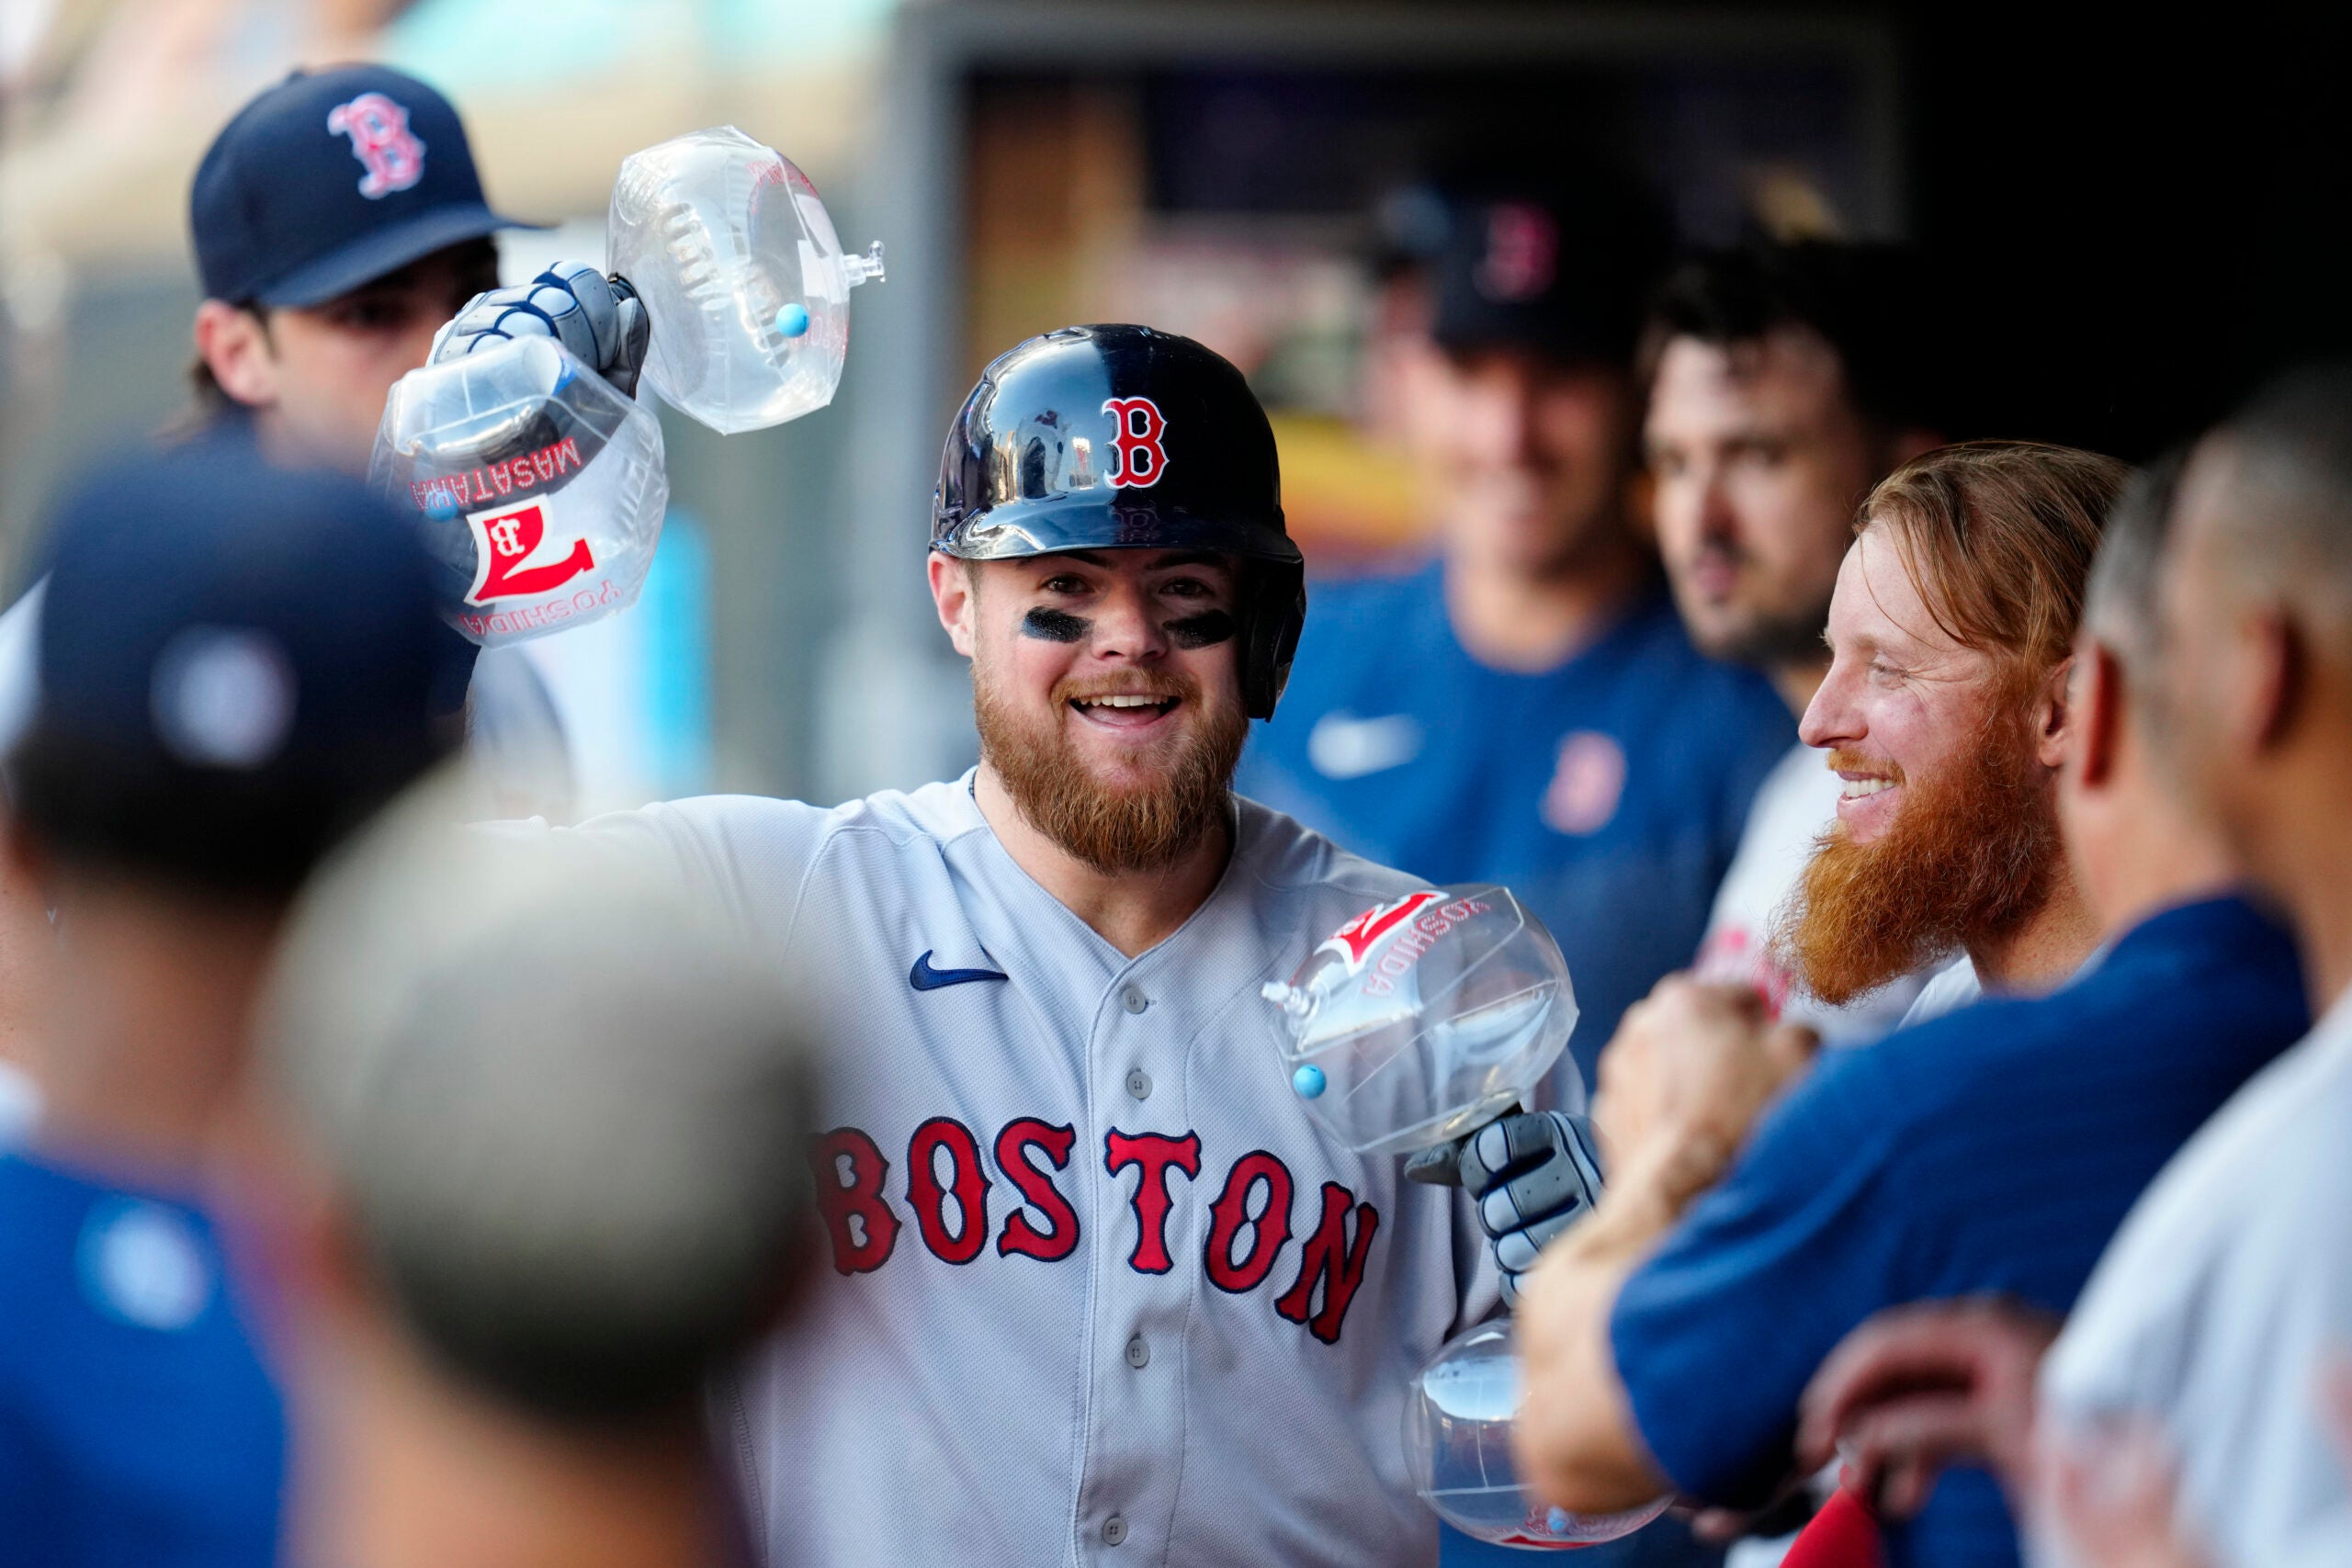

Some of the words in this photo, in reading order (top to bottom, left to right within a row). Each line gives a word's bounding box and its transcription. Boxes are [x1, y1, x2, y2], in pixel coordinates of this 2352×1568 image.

[327, 93, 426, 200] B
[410, 436, 582, 513] MASATAKA
[1101, 395, 1170, 490] B
[469, 501, 597, 605] 7
[489, 517, 526, 558] B
[459, 579, 625, 637] YOSHIDA
[1363, 896, 1494, 998] YOSHIDA
[808, 1114, 1381, 1346] BOSTON
